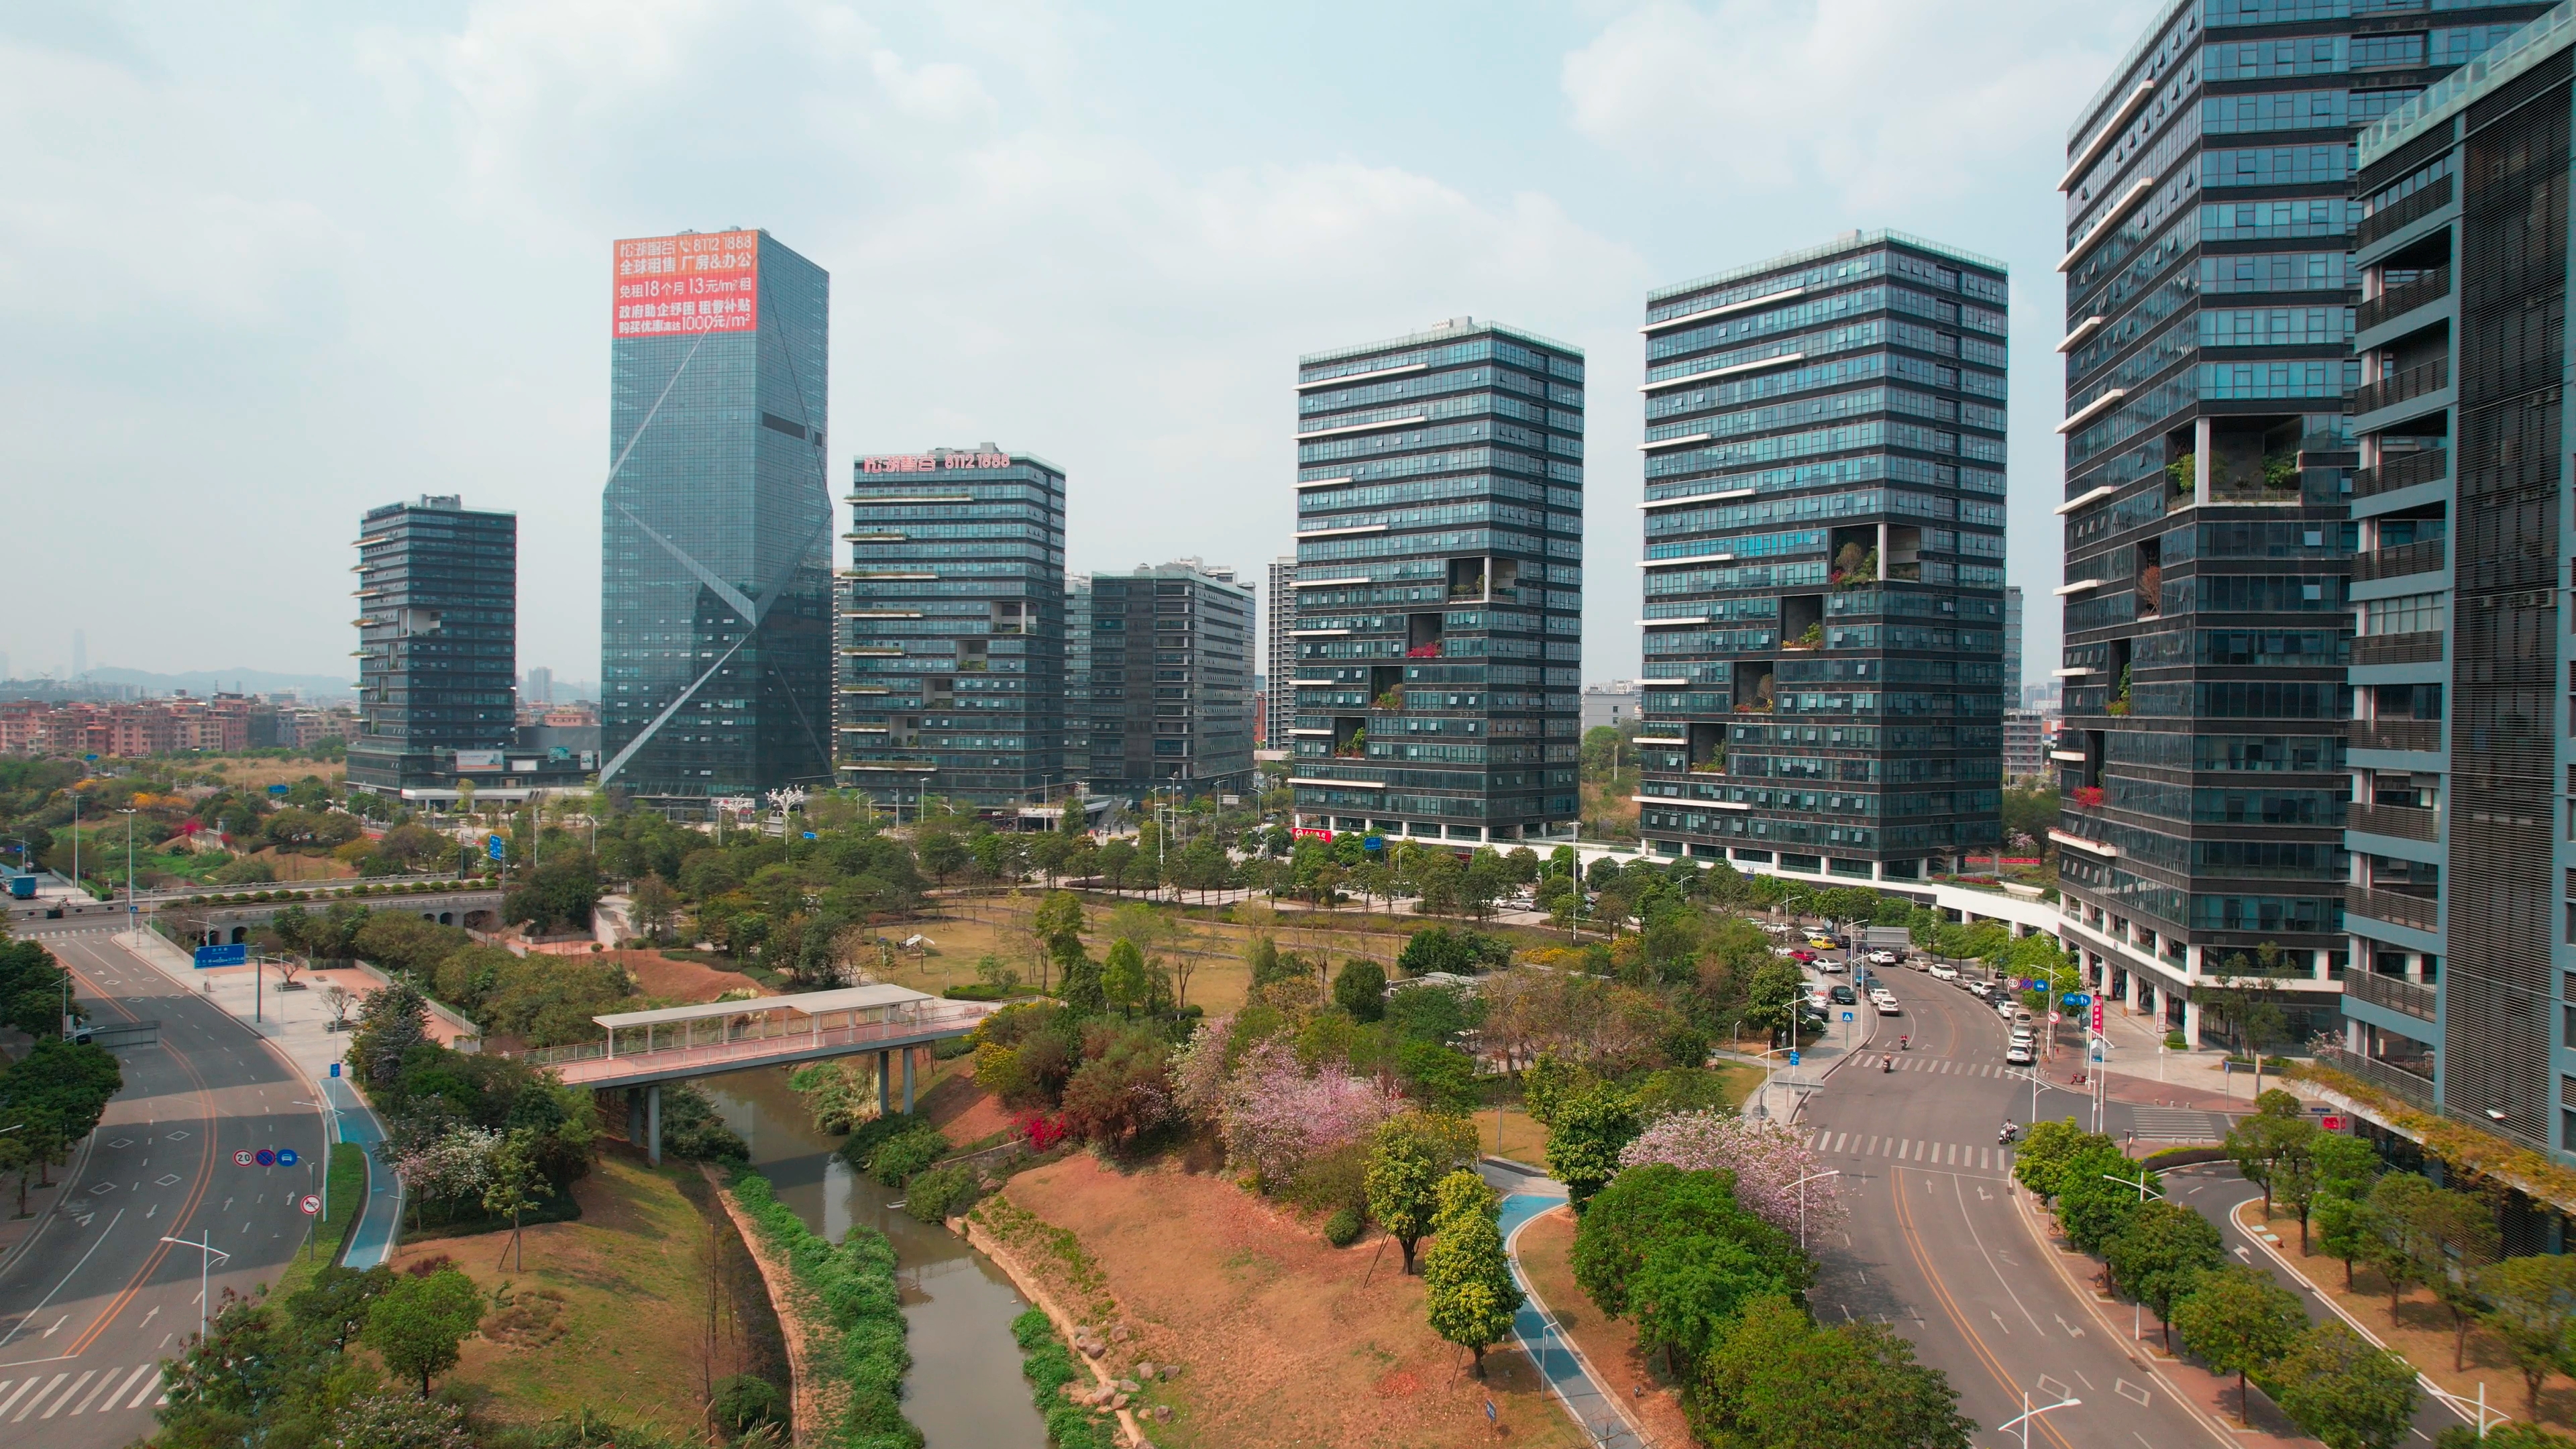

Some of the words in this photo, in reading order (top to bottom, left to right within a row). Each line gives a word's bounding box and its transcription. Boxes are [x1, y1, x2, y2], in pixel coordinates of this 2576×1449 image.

[620, 241, 676, 257] 松湖智谷
[694, 238, 719, 252] 8112
[723, 235, 752, 250] 1888
[620, 256, 676, 275] 全球租售
[681, 252, 751, 270] 厂房&办公
[620, 280, 684, 299] 免租18个月
[619, 301, 695, 319] 政府助企纾困
[864, 454, 936, 473] 松湖智谷
[945, 454, 975, 469] 8112
[977, 453, 1010, 468] 1888
[237, 1154, 250, 1162] 20
